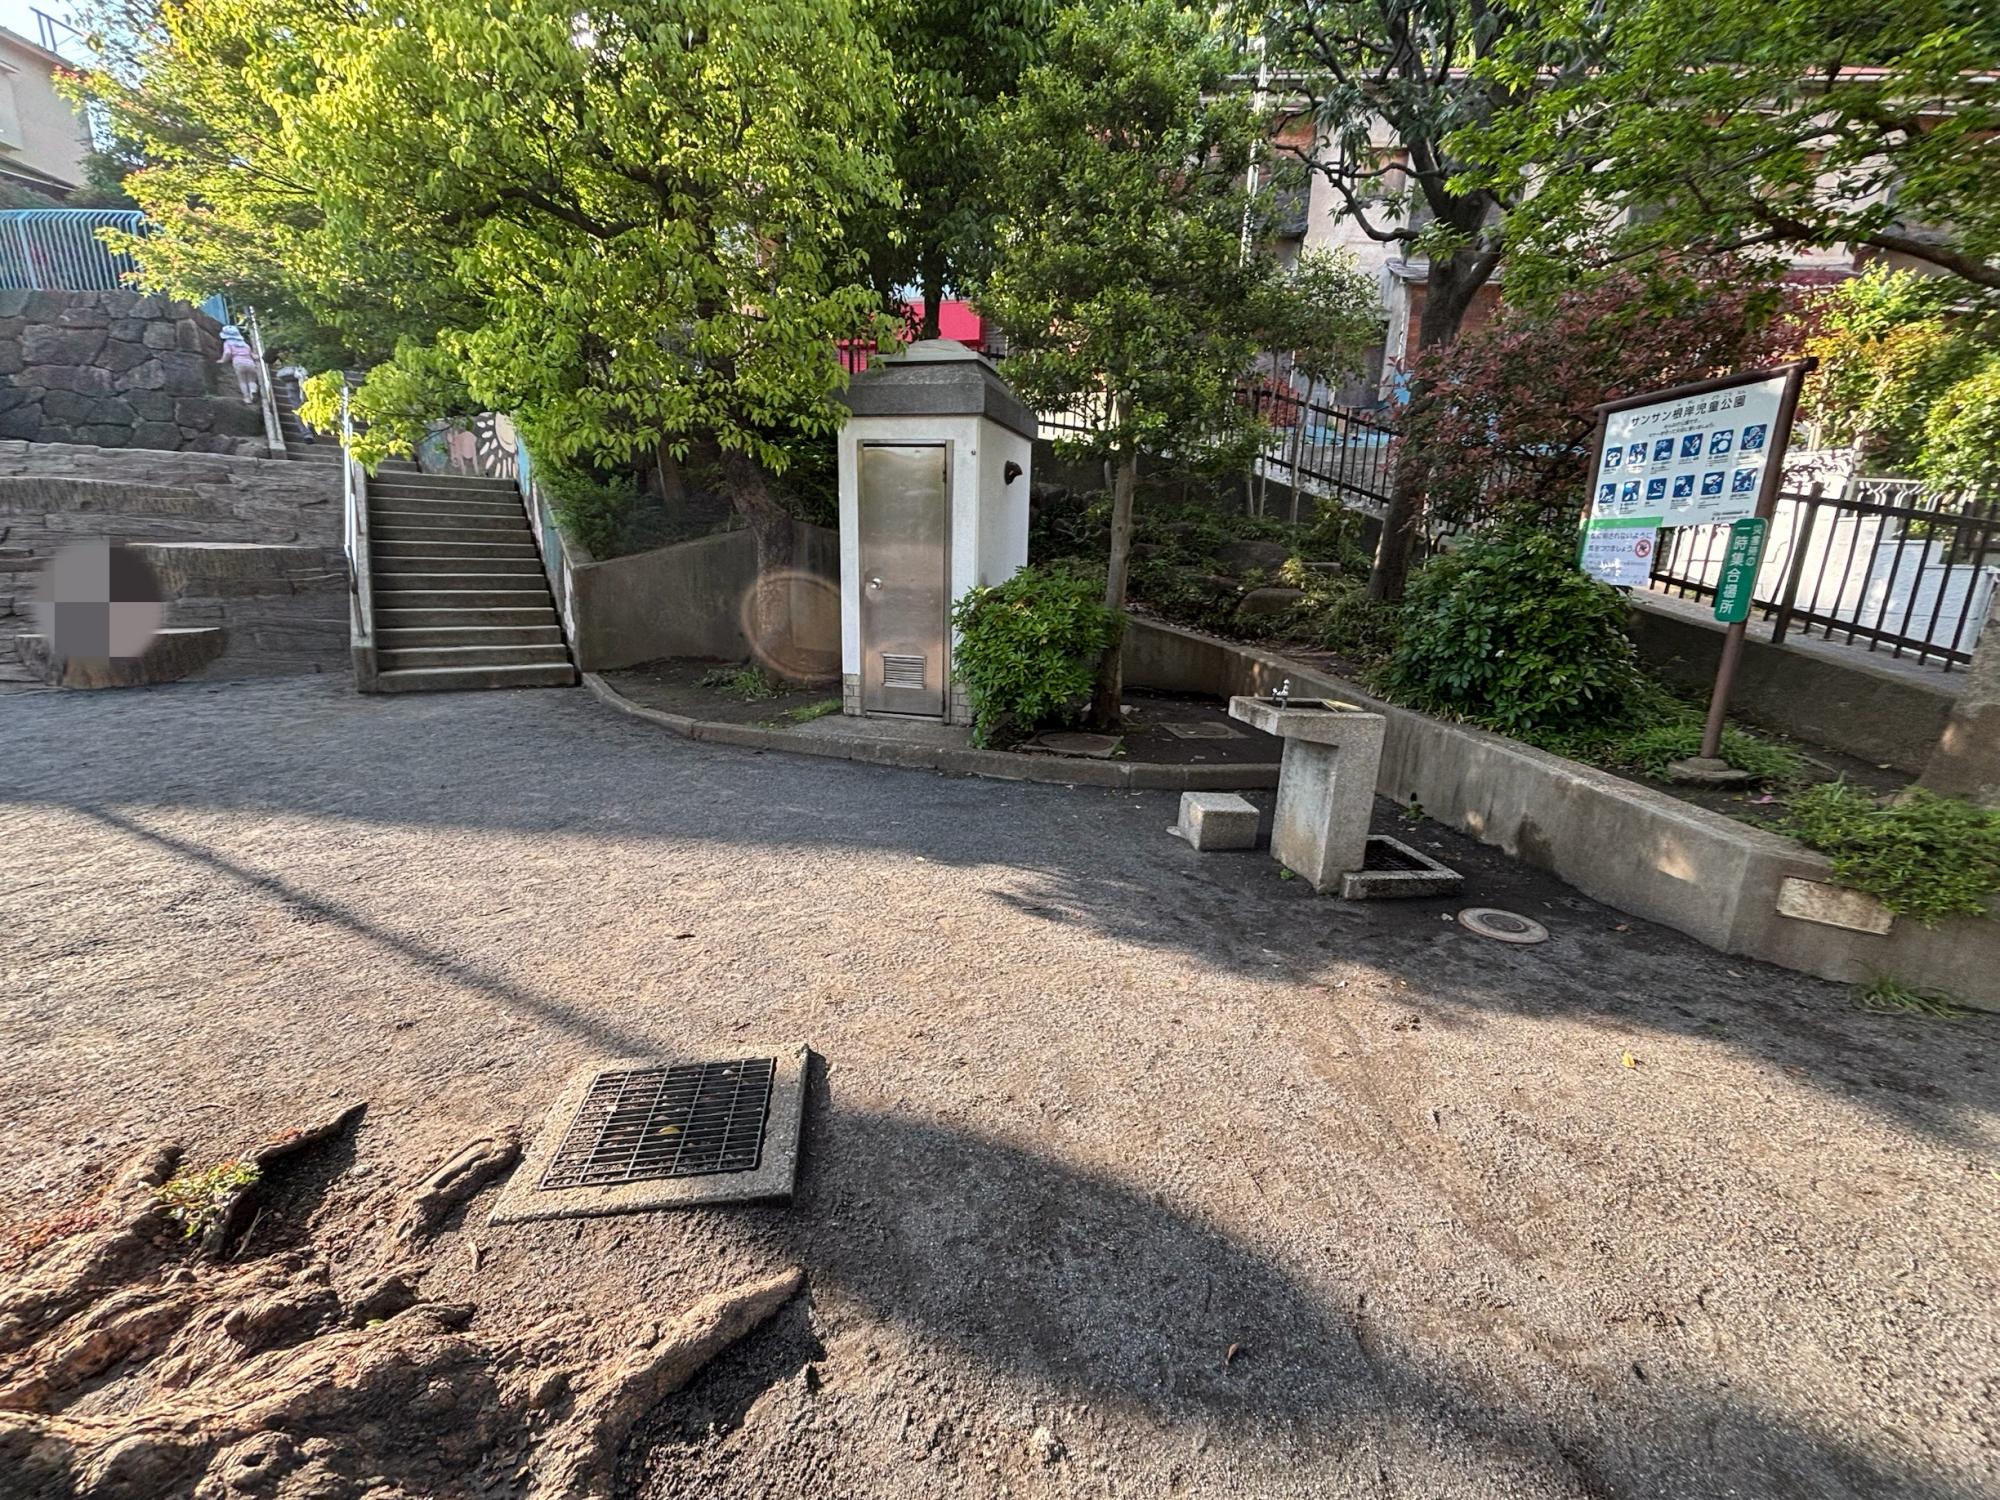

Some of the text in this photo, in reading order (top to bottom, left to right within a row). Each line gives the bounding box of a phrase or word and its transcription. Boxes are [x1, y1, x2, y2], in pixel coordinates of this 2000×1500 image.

[1718, 526, 1752, 615] 一時集合場所
